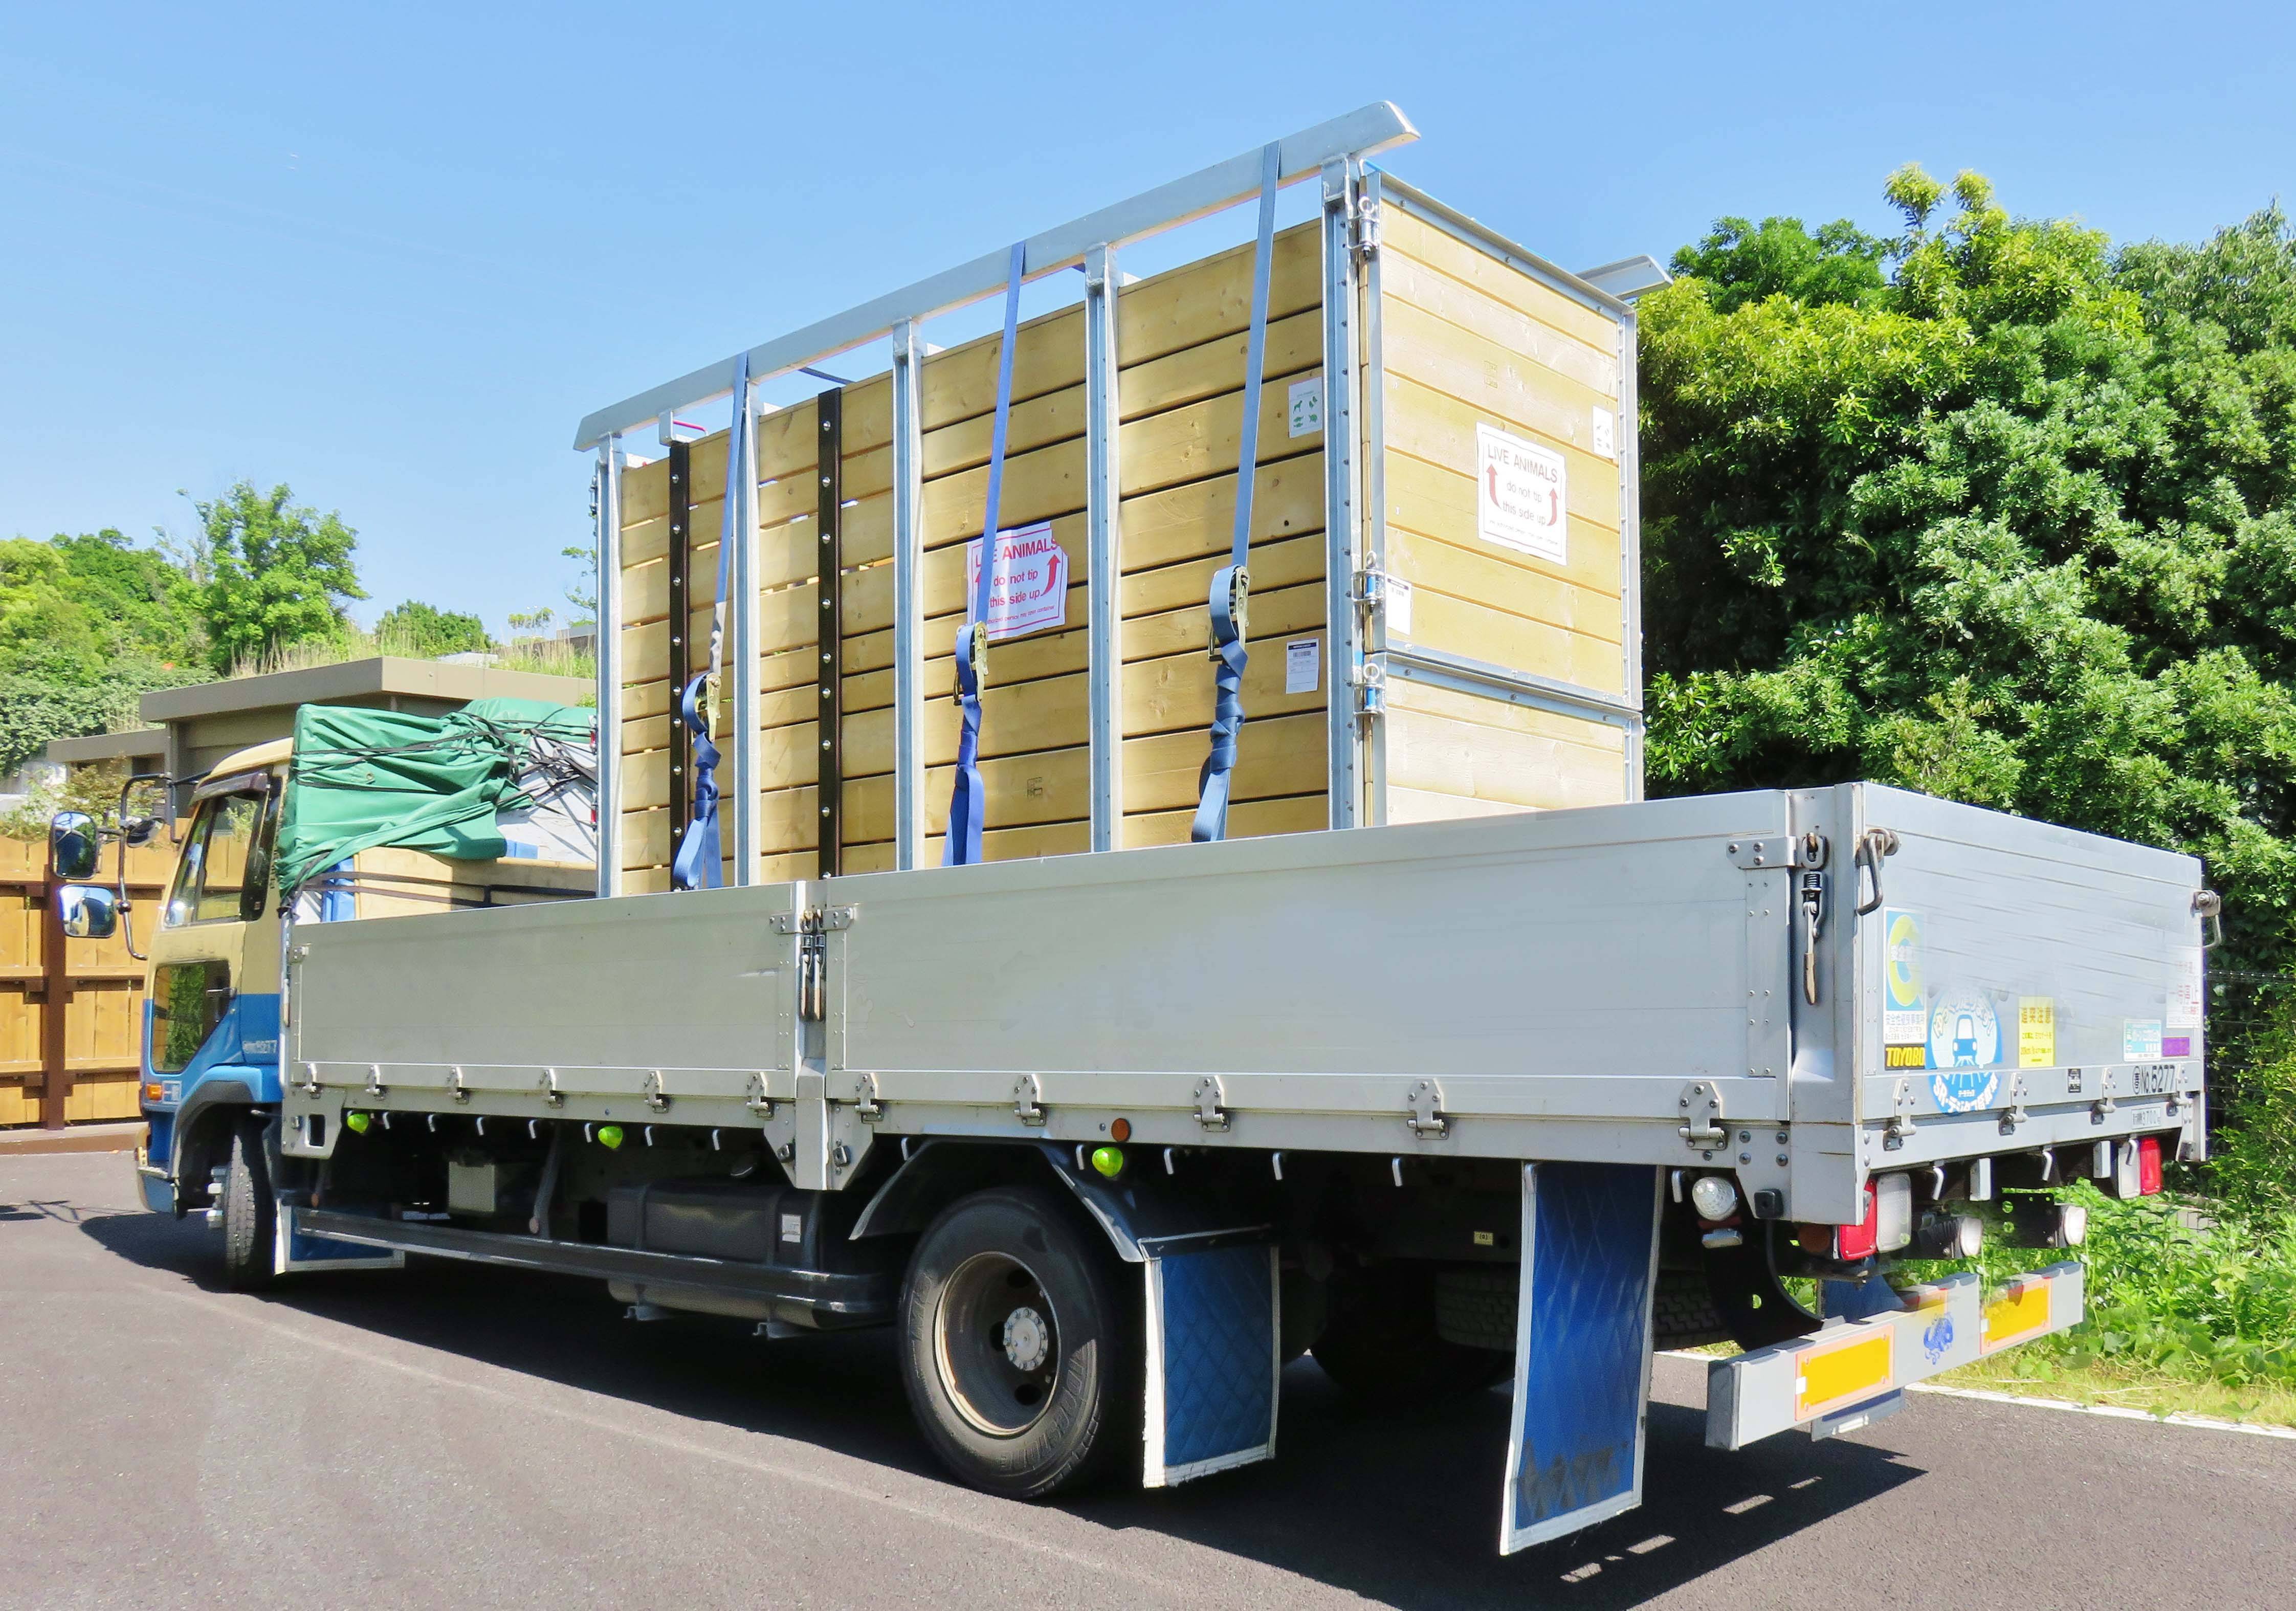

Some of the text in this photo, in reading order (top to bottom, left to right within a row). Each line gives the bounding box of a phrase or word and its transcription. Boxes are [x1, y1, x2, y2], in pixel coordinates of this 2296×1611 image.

[1487, 443, 1558, 483] LIVE ANIMALS
[1507, 481, 1542, 503] do not tip
[1502, 500, 1546, 527] this side up
[976, 536, 1058, 568] LE ANIMALS
[994, 569, 1039, 587] do not tip
[990, 589, 1041, 608] this side up
[1885, 1046, 1926, 1067] TOYOBO
